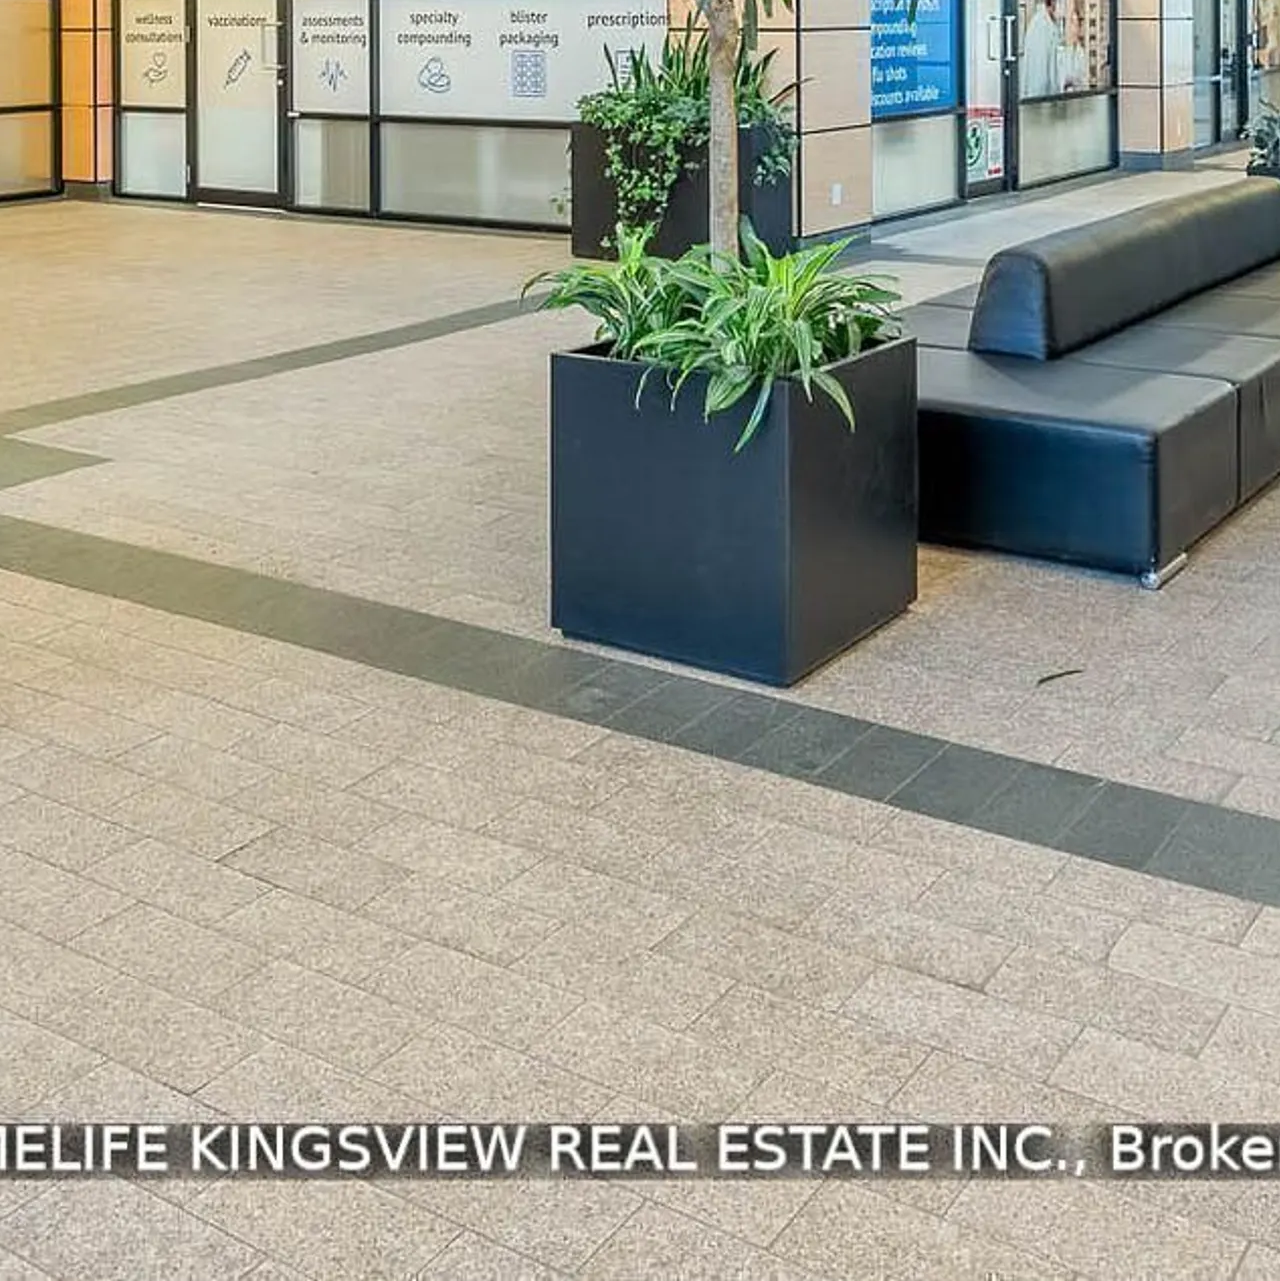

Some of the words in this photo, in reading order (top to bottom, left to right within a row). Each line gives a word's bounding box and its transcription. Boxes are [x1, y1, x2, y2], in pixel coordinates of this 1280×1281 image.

[301, 14, 365, 28] assessments
[409, 11, 460, 27] specialty
[510, 9, 549, 25] blister
[299, 32, 309, 45] &
[311, 32, 368, 49] monitoring
[397, 31, 472, 48] compounding
[499, 30, 560, 49] packaging
